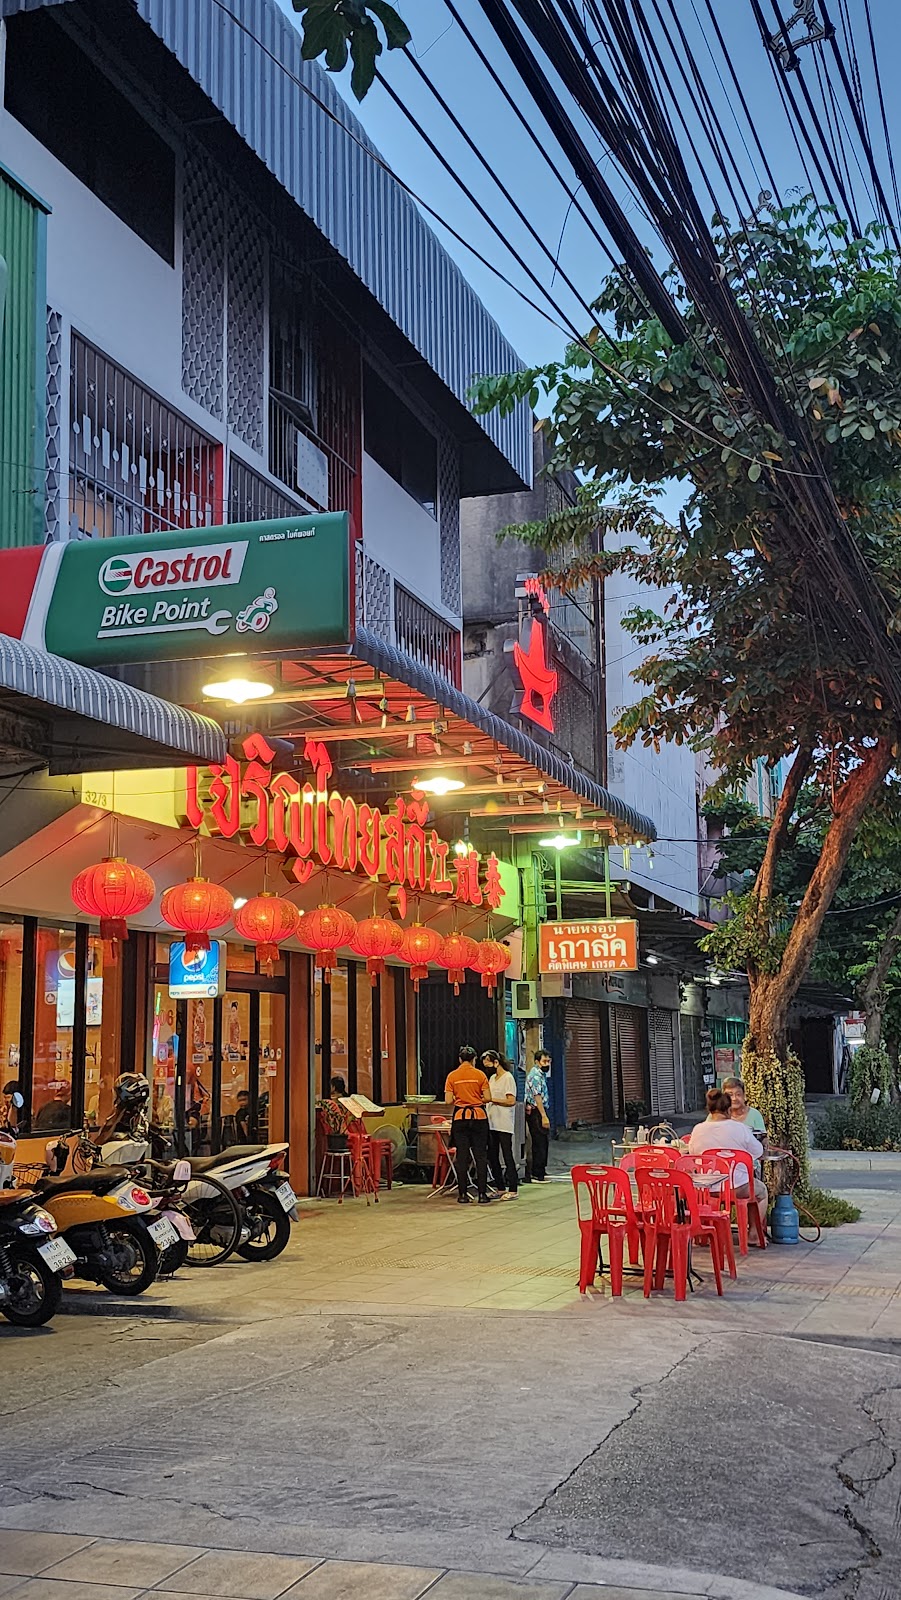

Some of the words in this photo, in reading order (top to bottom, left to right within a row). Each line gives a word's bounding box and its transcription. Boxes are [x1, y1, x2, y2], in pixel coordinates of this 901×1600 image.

[134, 547, 233, 589] Castrol
[100, 603, 148, 627] Bike
[152, 597, 211, 622] Point
[553, 924, 617, 935] นายหงอก
[620, 958, 628, 968] A
[184, 972, 205, 983] pepsi
